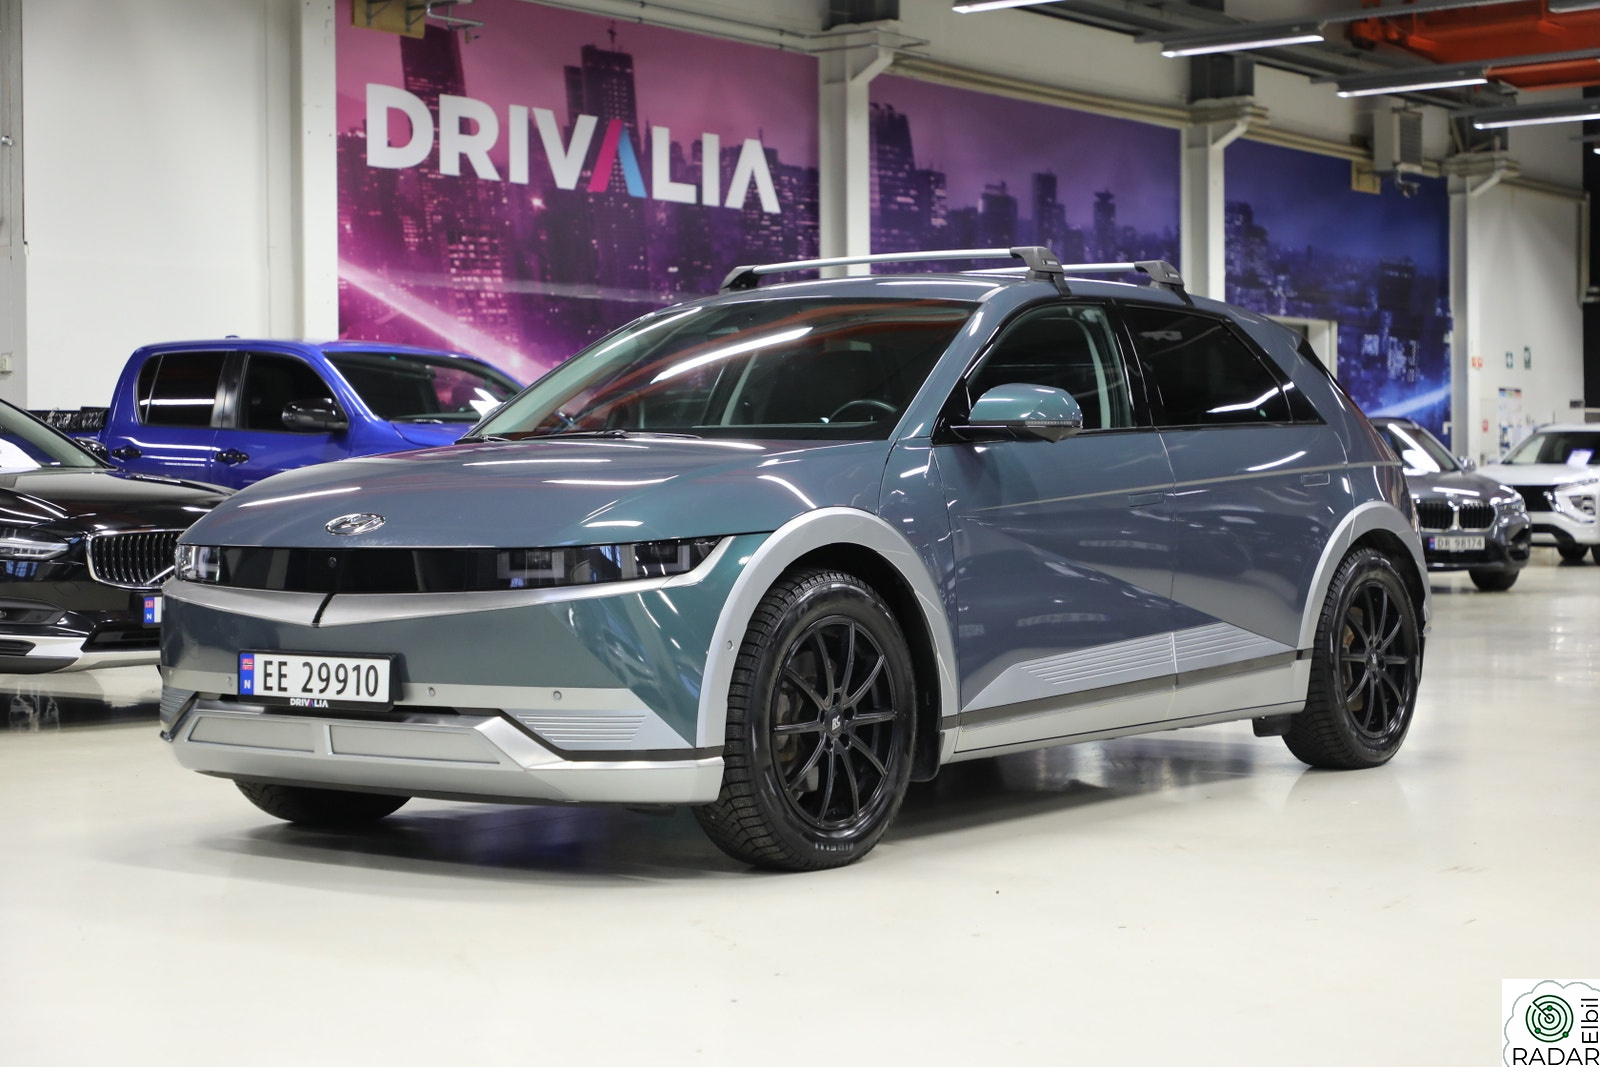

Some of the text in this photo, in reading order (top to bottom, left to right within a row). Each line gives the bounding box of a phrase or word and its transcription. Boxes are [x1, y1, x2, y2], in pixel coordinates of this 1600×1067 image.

[366, 83, 781, 214] DRIVALIA
[1455, 538, 1482, 548] 98174
[244, 679, 251, 689] N
[263, 660, 379, 697] EE 29910
[289, 697, 329, 708] DRIVALIA
